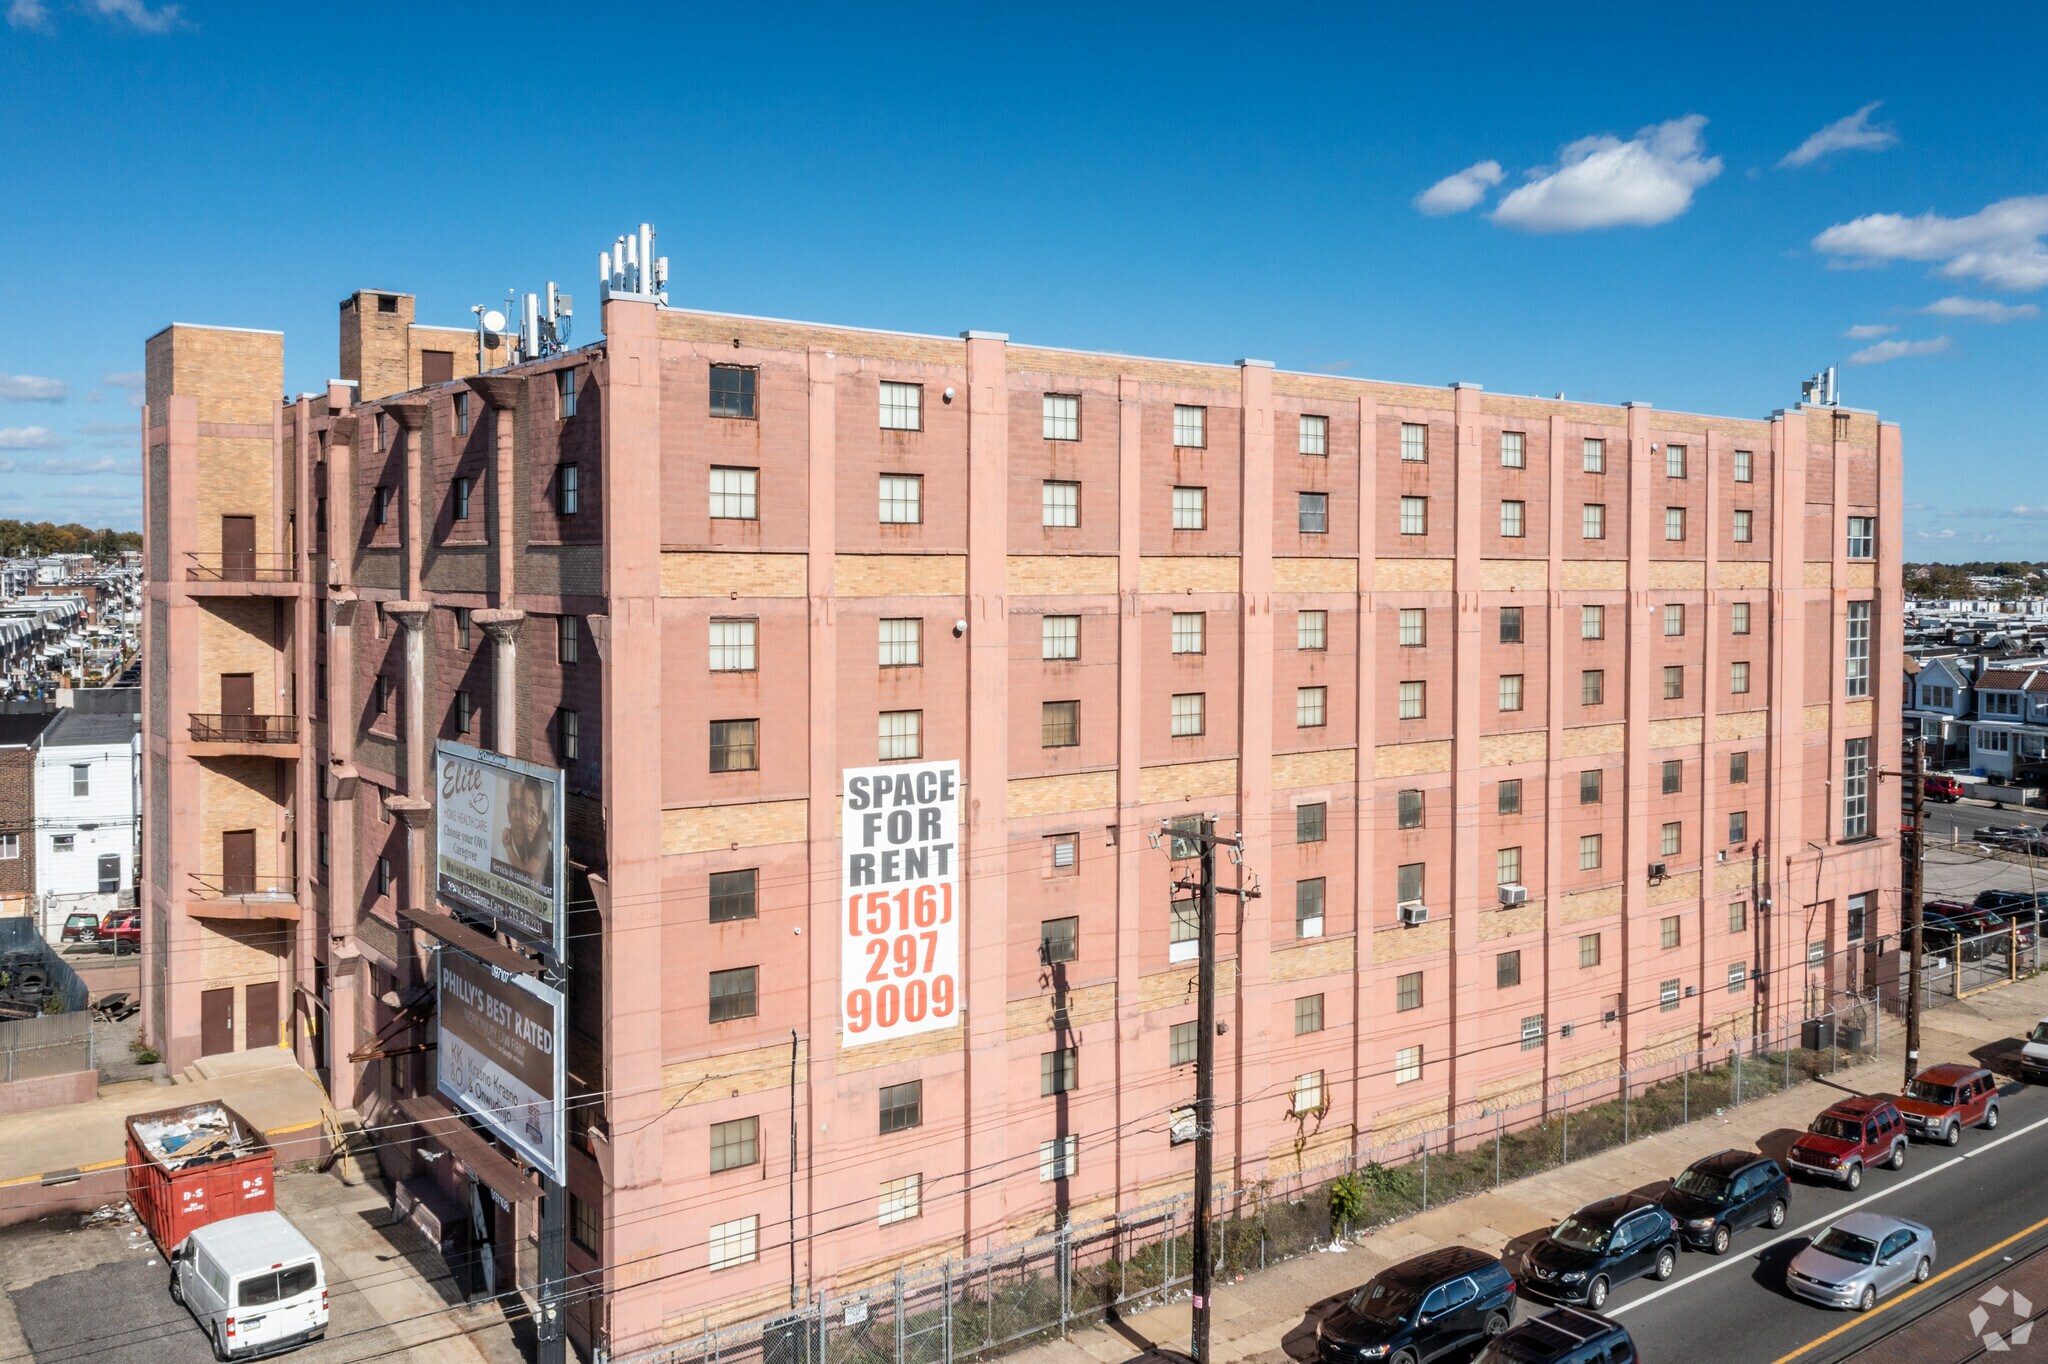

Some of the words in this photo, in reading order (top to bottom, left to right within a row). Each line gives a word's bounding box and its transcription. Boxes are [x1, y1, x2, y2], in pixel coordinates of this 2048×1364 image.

[442, 761, 482, 800] Elite
[849, 769, 955, 811] SPACE
[444, 825, 461, 840] Choose
[461, 832, 474, 845] your
[474, 836, 488, 850] OWN
[475, 818, 487, 832] CARE
[863, 807, 942, 848] FOR
[453, 843, 477, 862] Caregiver
[850, 842, 954, 887] RENT
[466, 867, 491, 888] Services
[496, 880, 529, 906] Pediatrics
[849, 883, 952, 937] (516)
[865, 930, 938, 983] 297
[443, 967, 484, 1012] PHILLY'S
[486, 993, 513, 1030] BEST
[515, 1011, 553, 1055] RATED
[846, 974, 955, 1033] 9009
[467, 1056, 492, 1087] Krasno
[493, 1075, 519, 1107] Krasno
